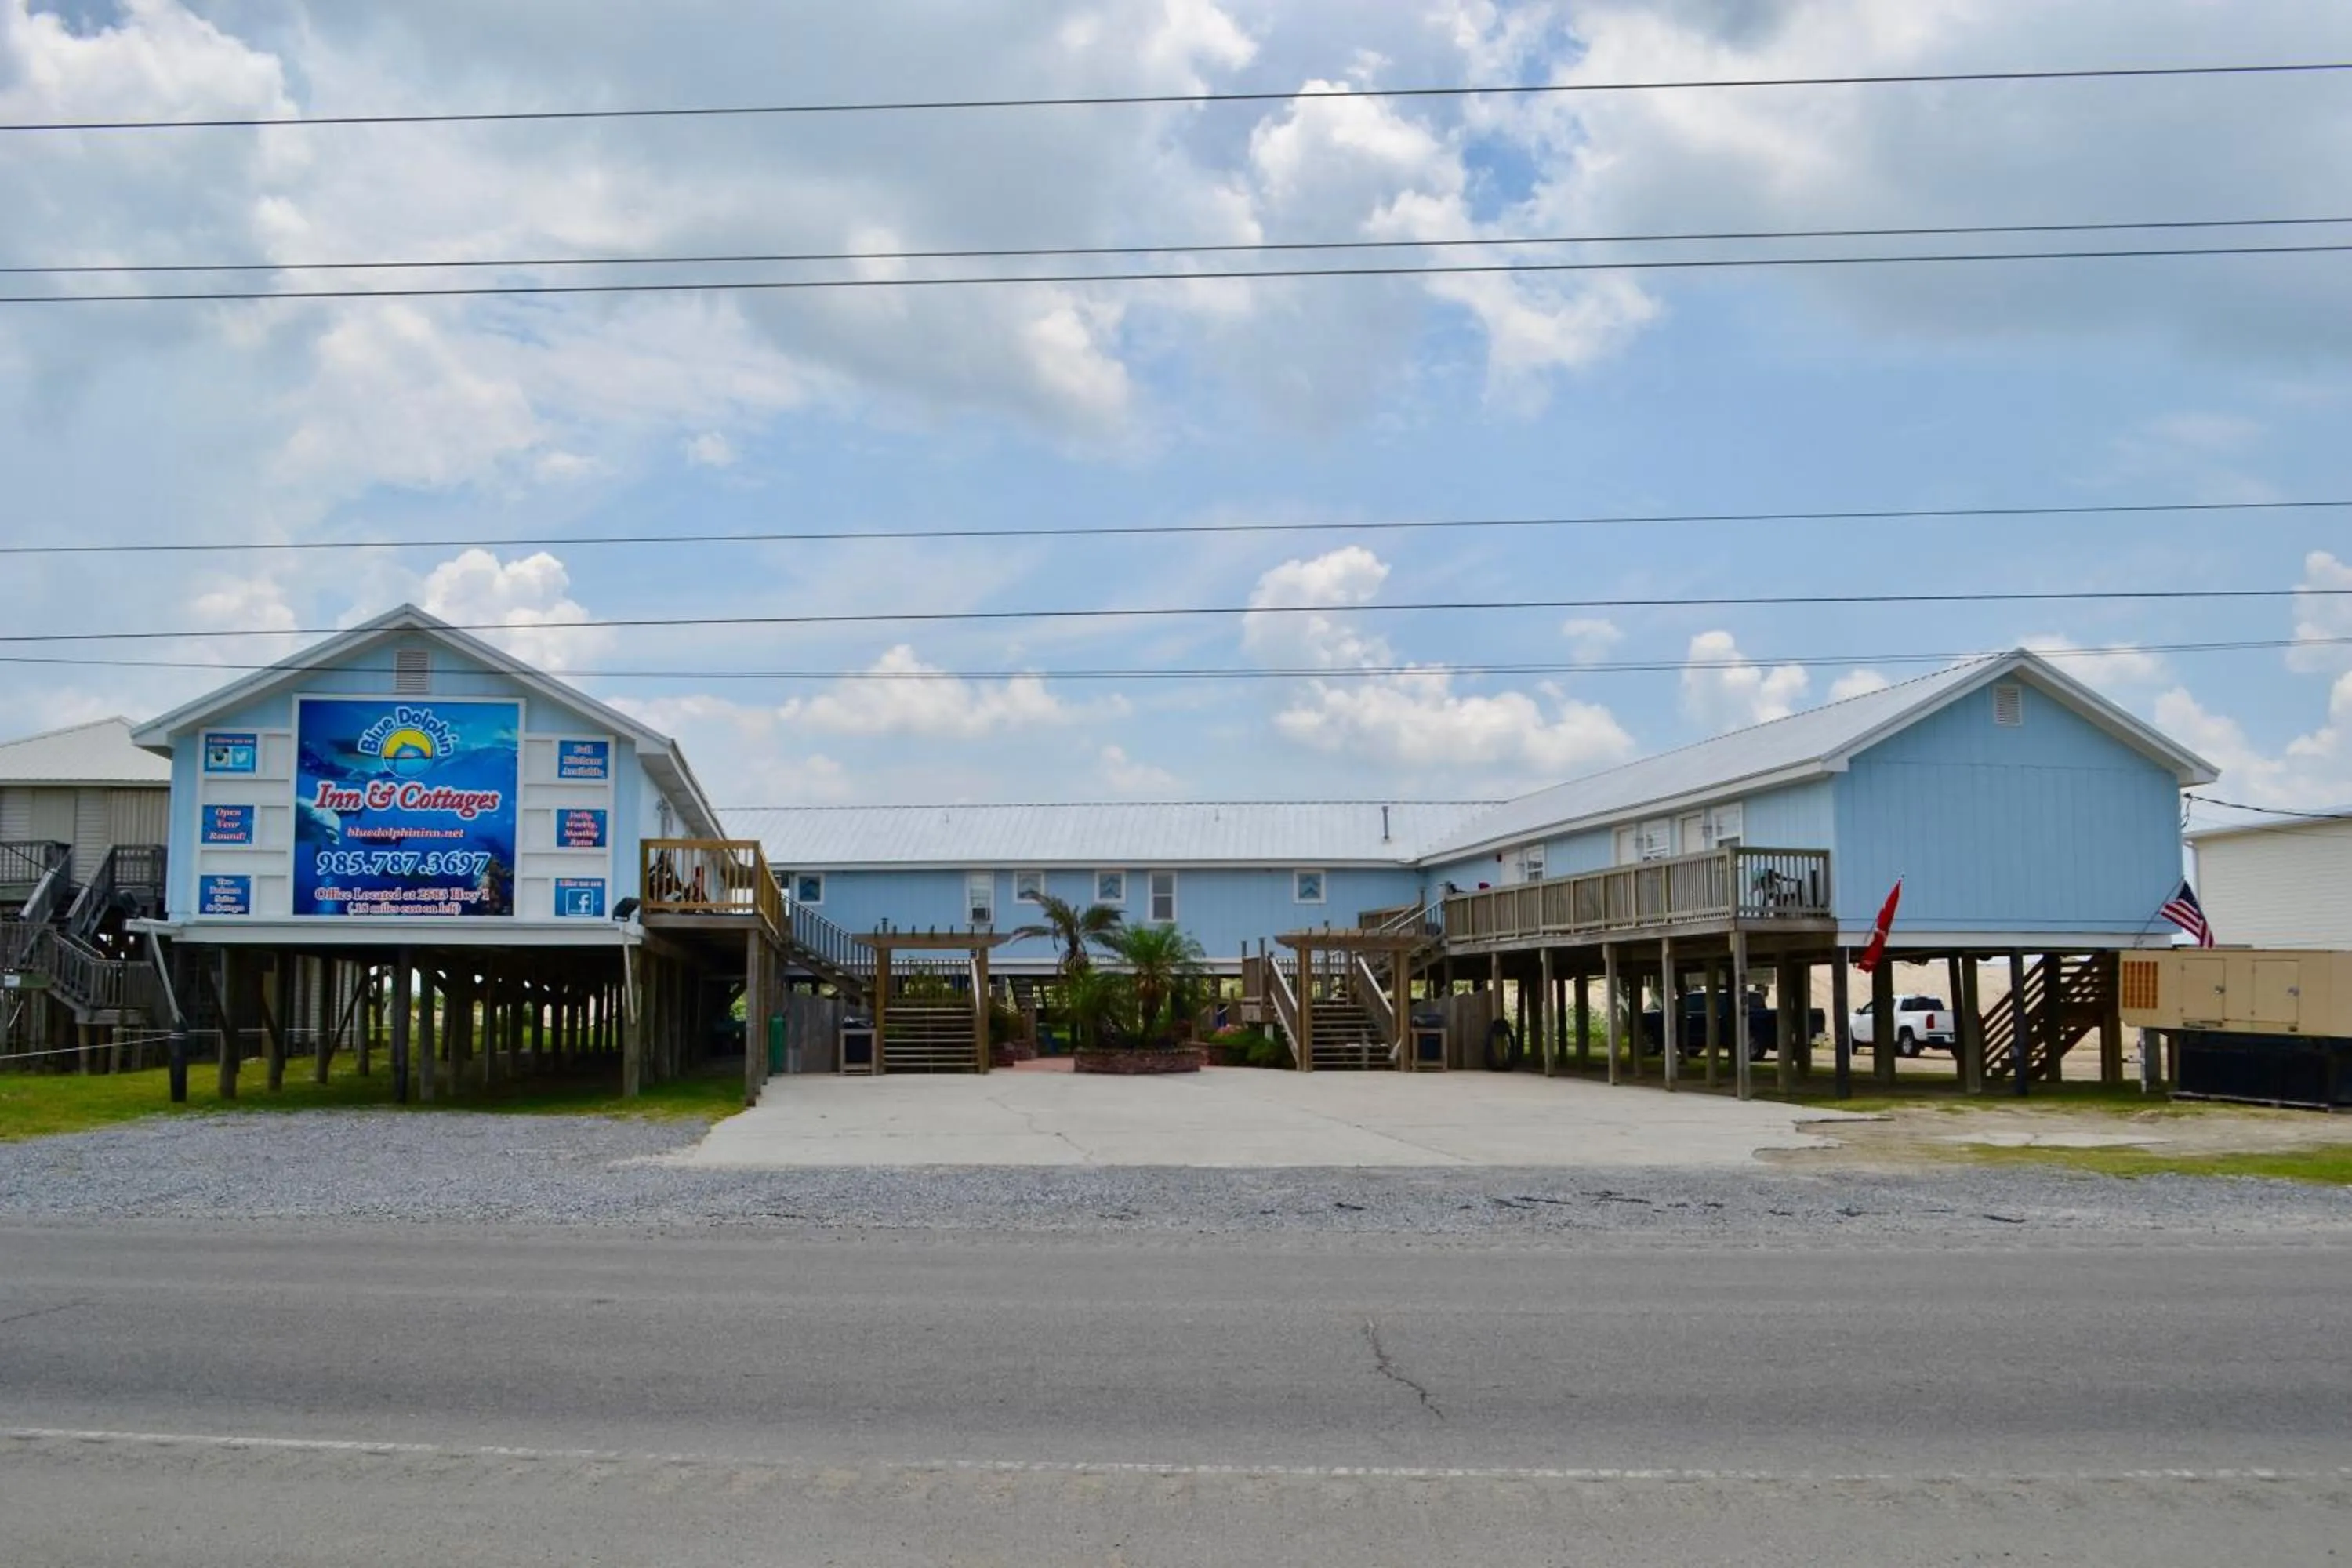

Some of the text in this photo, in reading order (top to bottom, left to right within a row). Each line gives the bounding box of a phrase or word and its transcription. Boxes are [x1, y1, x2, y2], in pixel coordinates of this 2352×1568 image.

[358, 706, 458, 757] Blue Dolphin
[315, 780, 501, 820] Inn & Cottages
[347, 826, 464, 840] bluedolphininn.net
[316, 851, 491, 876] 985.787.3697
[314, 887, 352, 901] Office
[353, 887, 401, 901] Located
[402, 890, 416, 901] at
